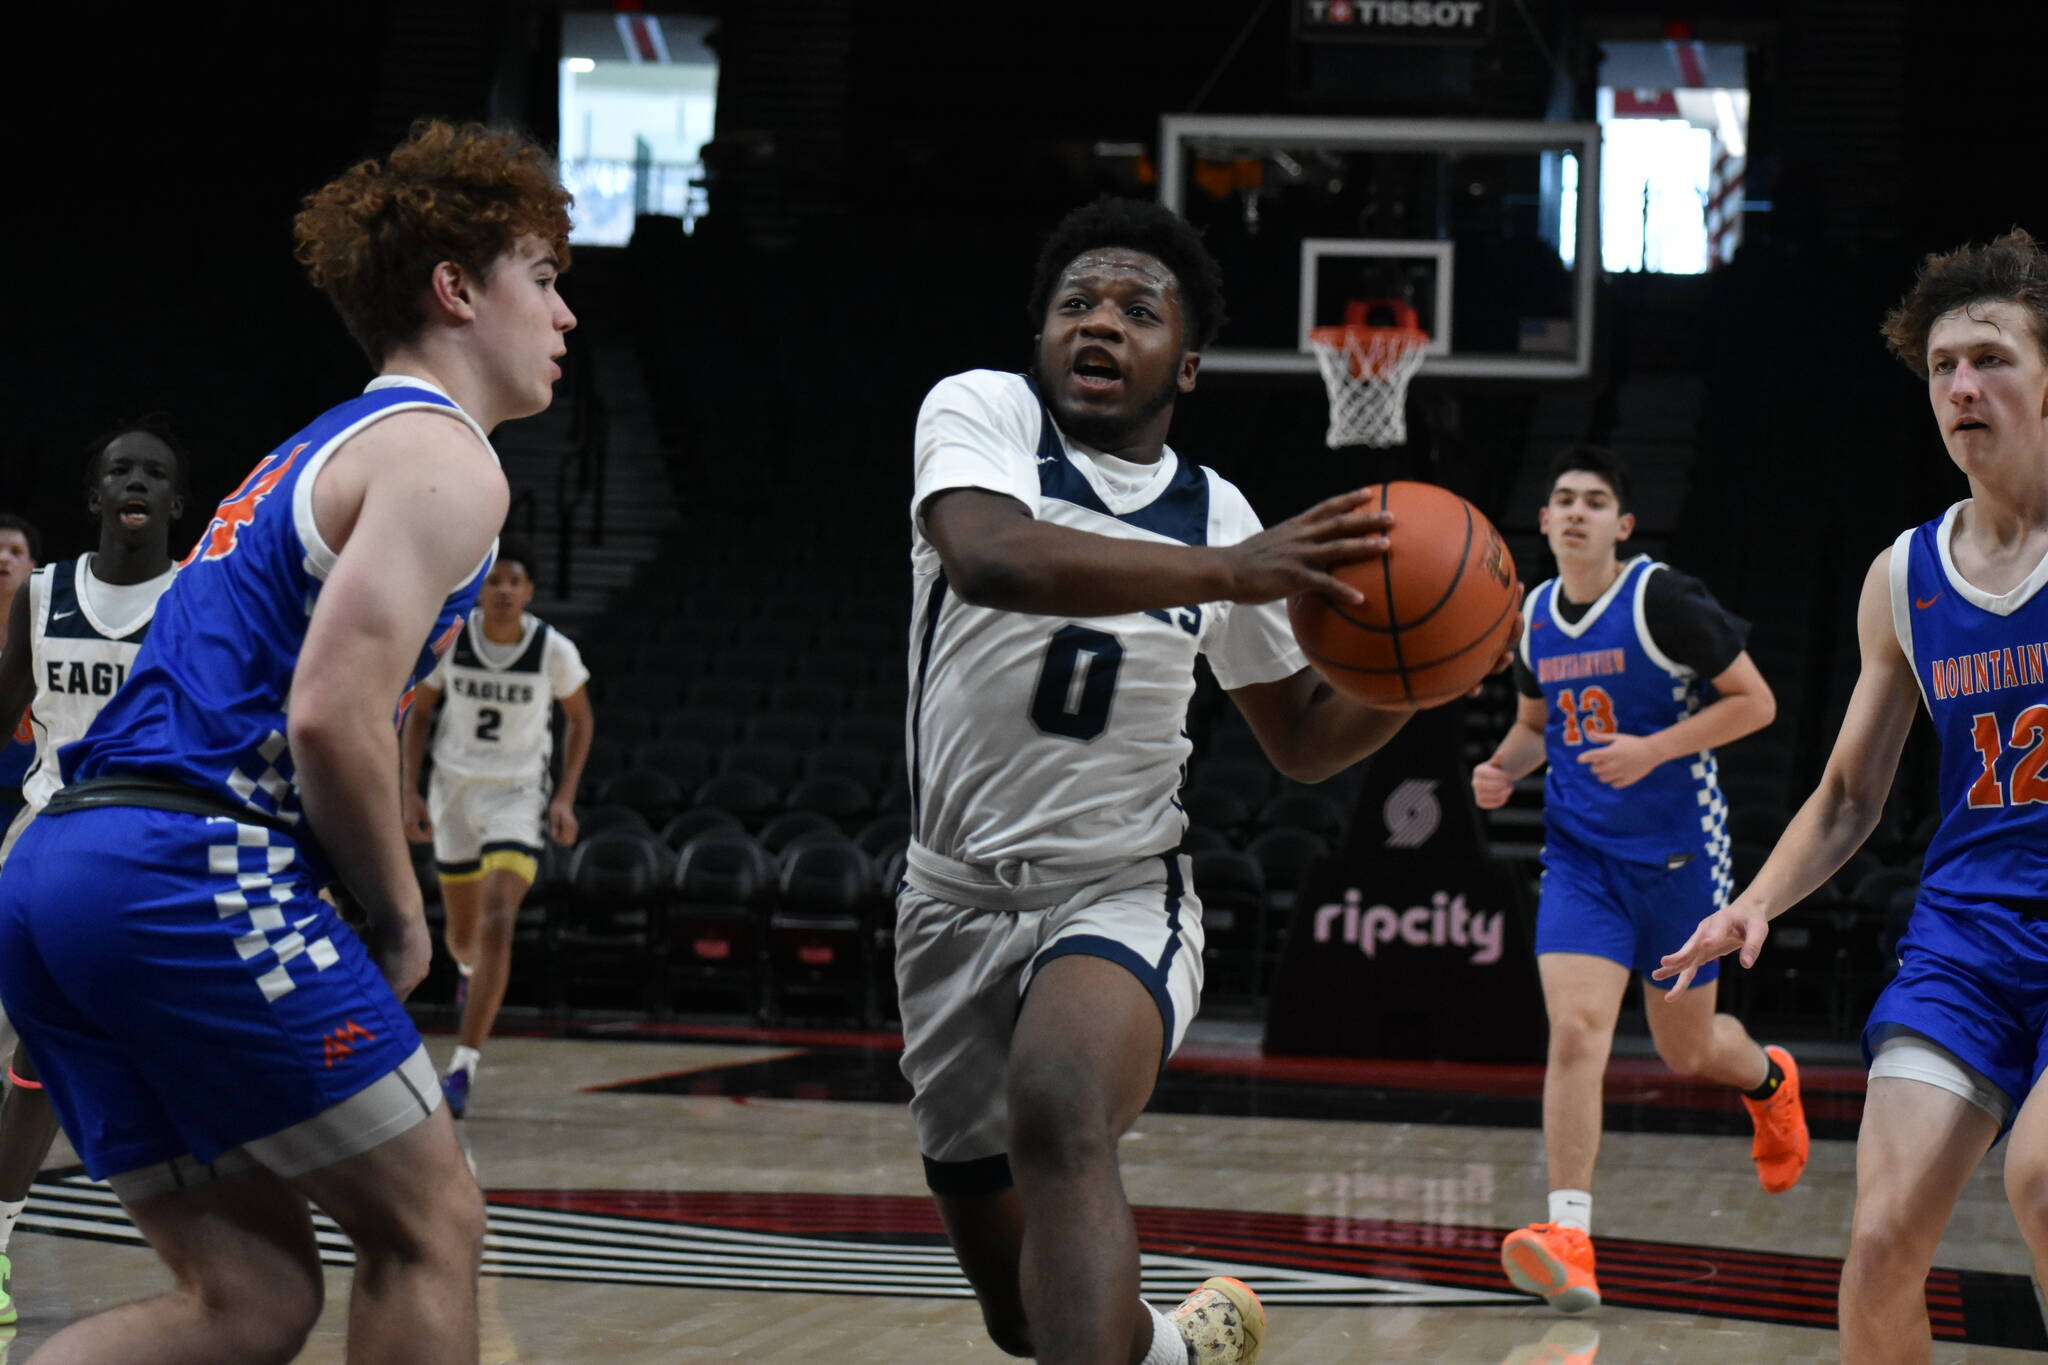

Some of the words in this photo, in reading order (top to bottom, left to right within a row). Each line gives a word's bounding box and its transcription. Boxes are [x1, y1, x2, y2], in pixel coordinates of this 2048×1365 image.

[1356, 1, 1483, 28] TISSOT
[453, 678, 533, 704] EAGLES
[1026, 621, 1126, 745] 0
[476, 707, 502, 742] 2
[1556, 685, 1618, 747] 13
[1967, 703, 2048, 809] 12
[1313, 886, 1505, 966] ripcity
